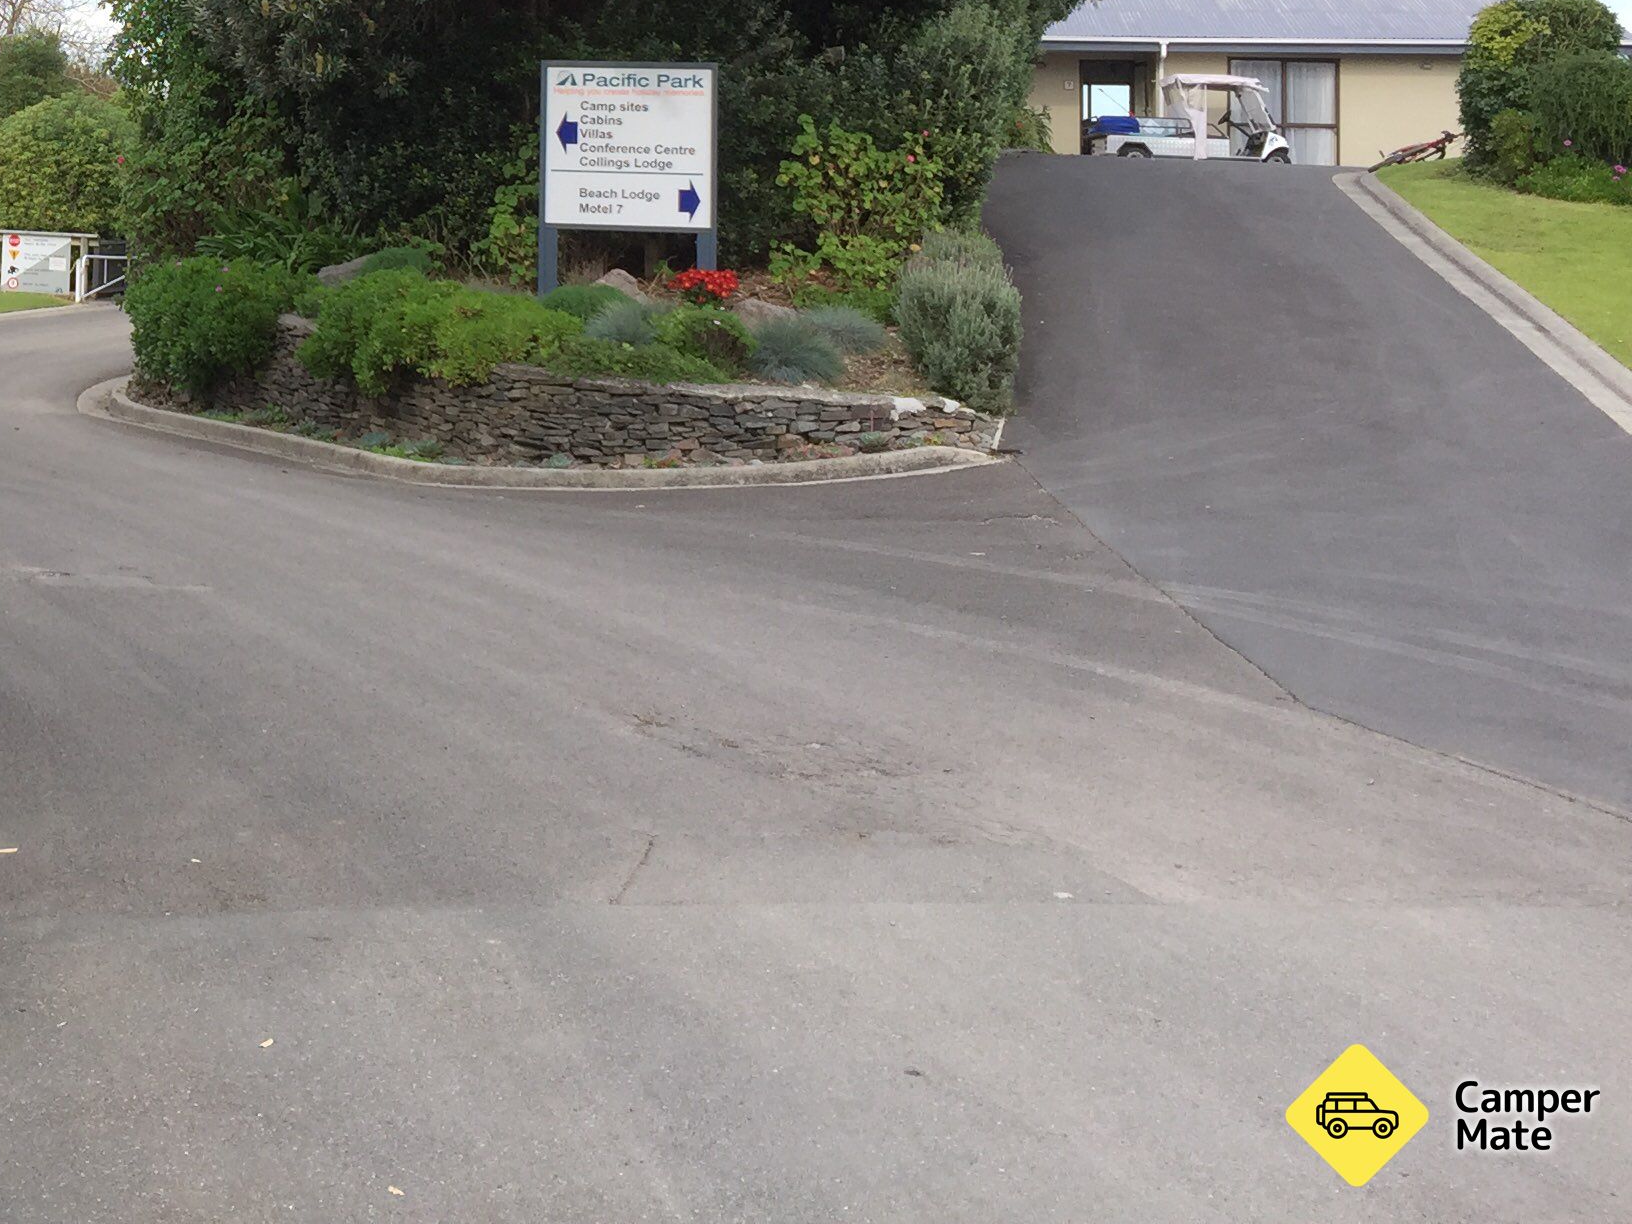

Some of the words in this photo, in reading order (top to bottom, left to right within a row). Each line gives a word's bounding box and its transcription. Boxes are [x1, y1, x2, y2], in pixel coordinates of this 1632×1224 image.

[582, 73, 649, 88] Pacific
[657, 74, 704, 89] Park
[580, 100, 616, 113] Camp
[619, 101, 649, 112] sites
[579, 114, 623, 126] Cabins
[579, 128, 613, 139] Villas
[579, 142, 651, 154] Conference
[654, 144, 696, 155] Centre
[579, 156, 630, 169] Collings
[634, 158, 673, 171] Lodge
[578, 187, 617, 199] Beach
[621, 189, 661, 202] Lodge
[578, 203, 613, 214] Motel
[616, 204, 624, 214] 7
